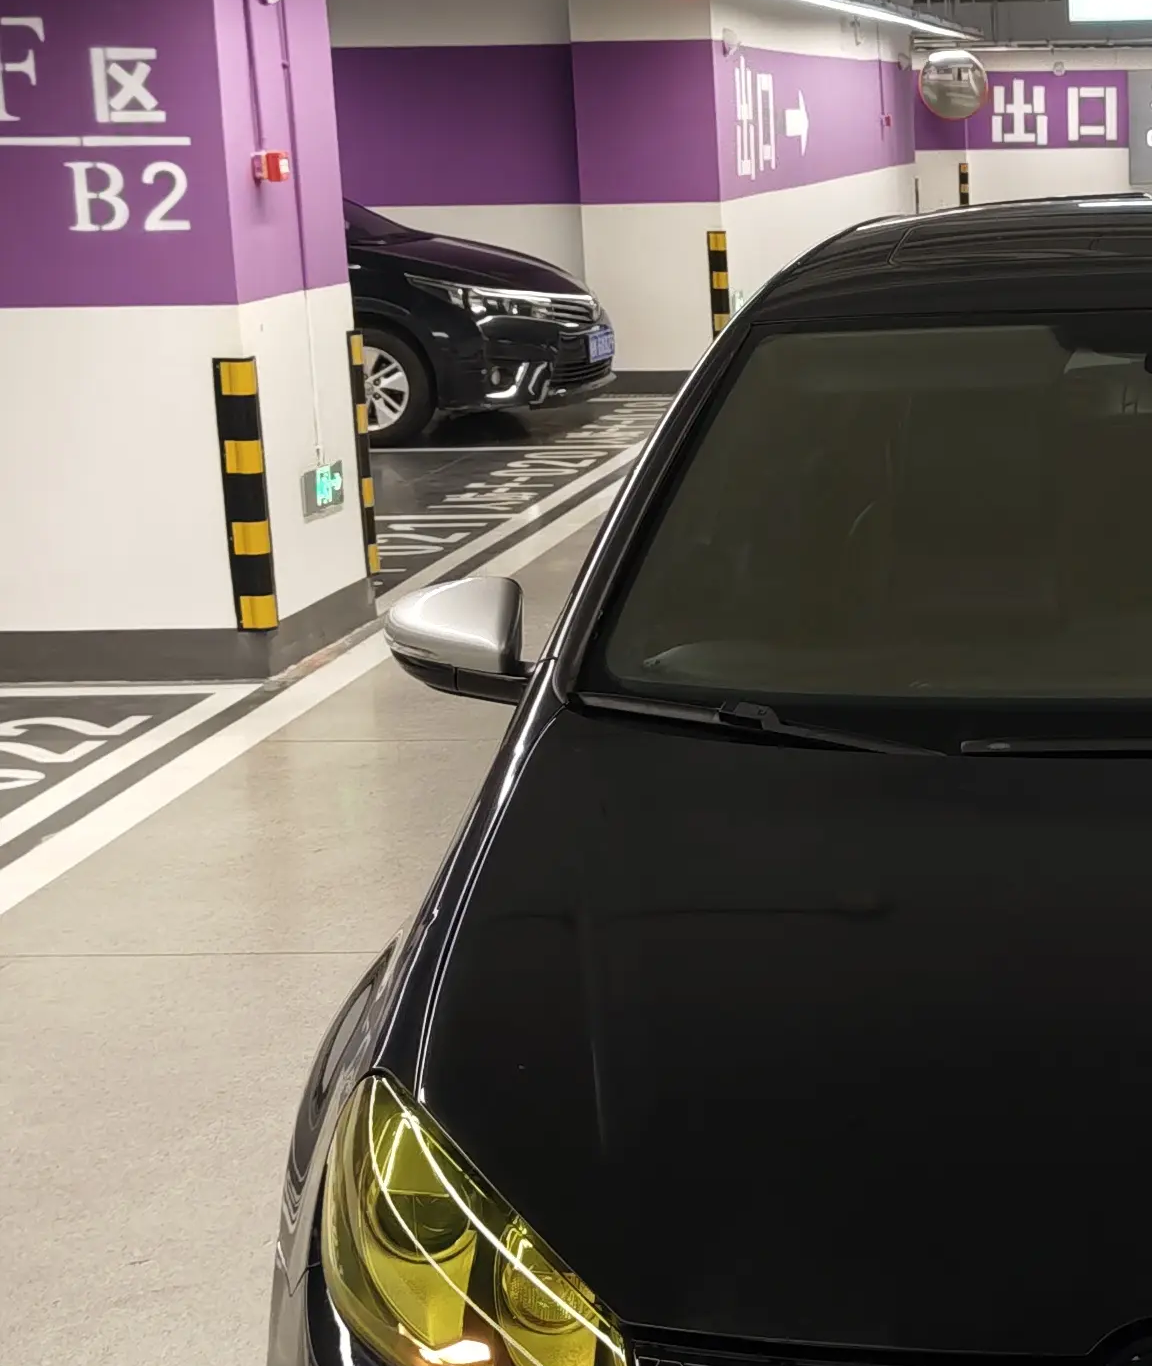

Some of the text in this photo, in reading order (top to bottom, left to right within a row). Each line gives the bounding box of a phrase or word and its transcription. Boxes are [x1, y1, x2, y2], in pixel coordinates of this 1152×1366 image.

[735, 55, 776, 181] 出口
[991, 79, 1119, 147] 出口
[63, 161, 191, 232] B2
